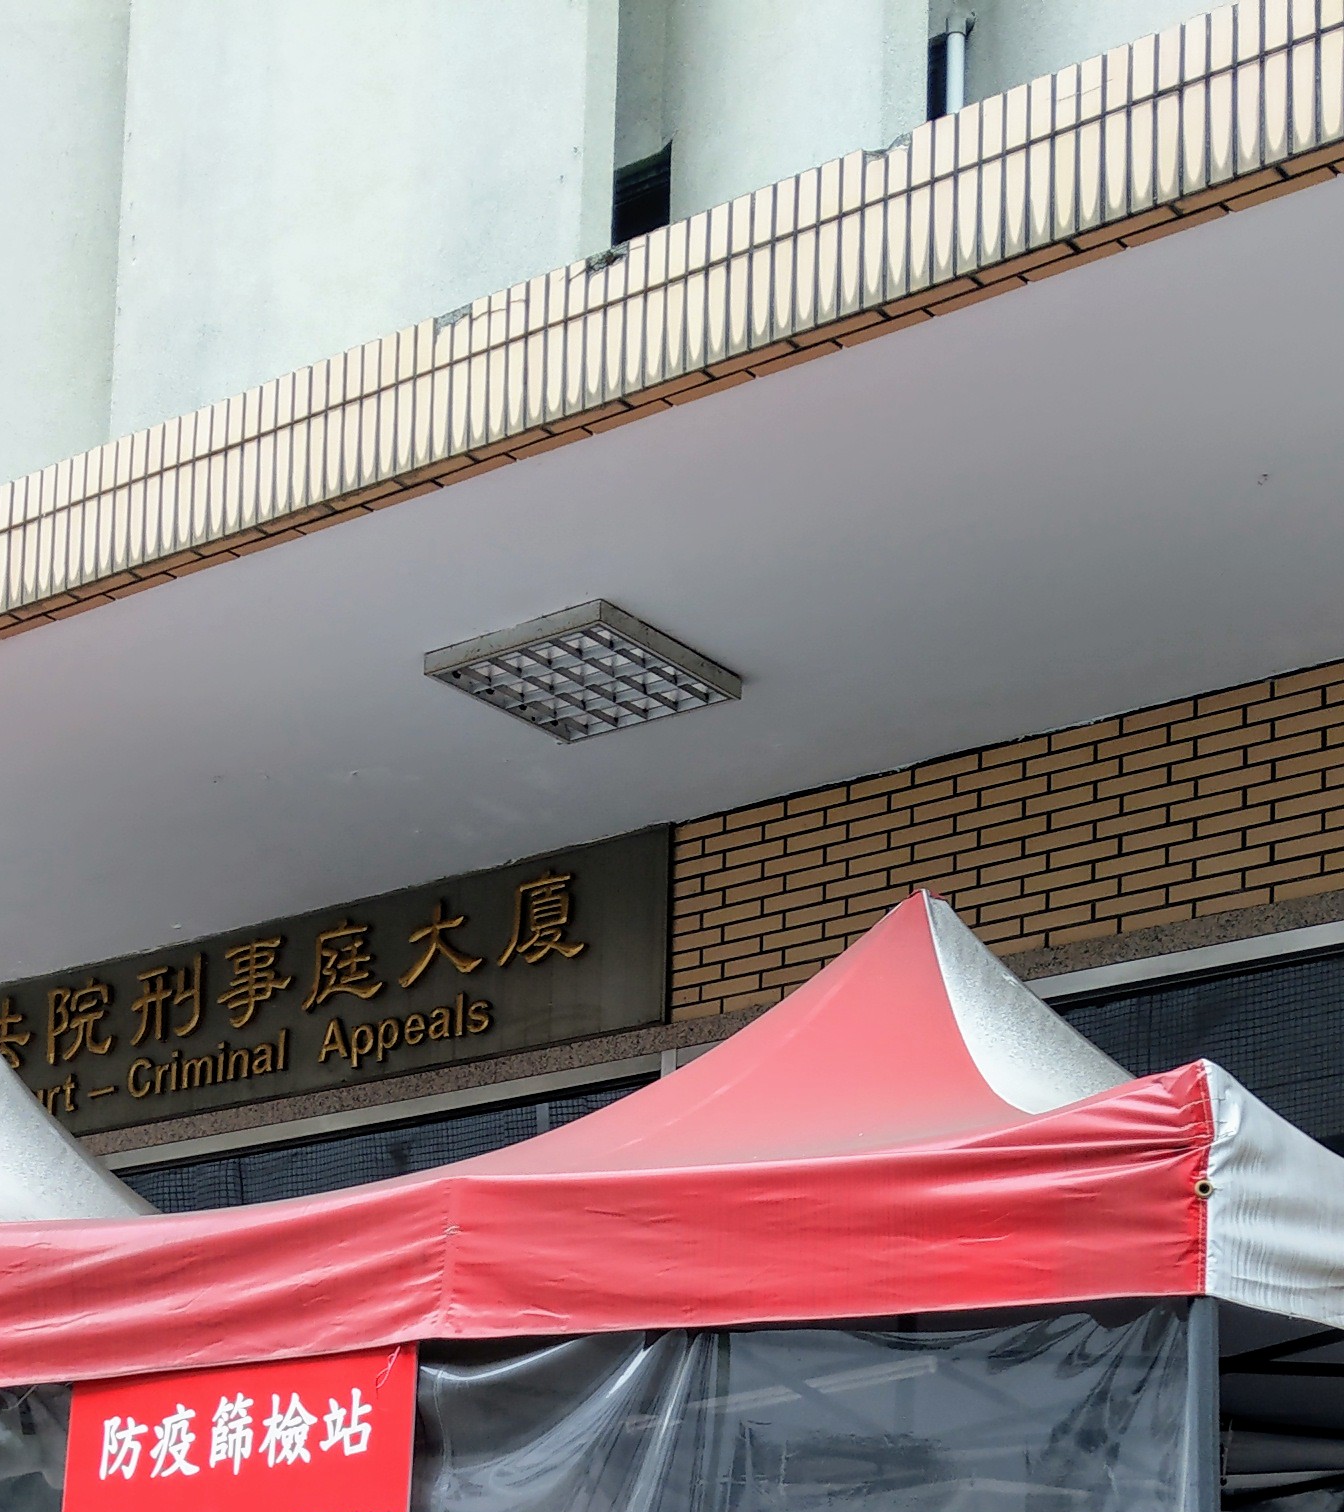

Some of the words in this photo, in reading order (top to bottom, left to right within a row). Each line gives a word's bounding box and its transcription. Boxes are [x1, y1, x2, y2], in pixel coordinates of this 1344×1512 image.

[128, 1029, 290, 1101] Criminal
[318, 996, 496, 1071] Appeals
[98, 1387, 373, 1481] 防疫篩檢站
